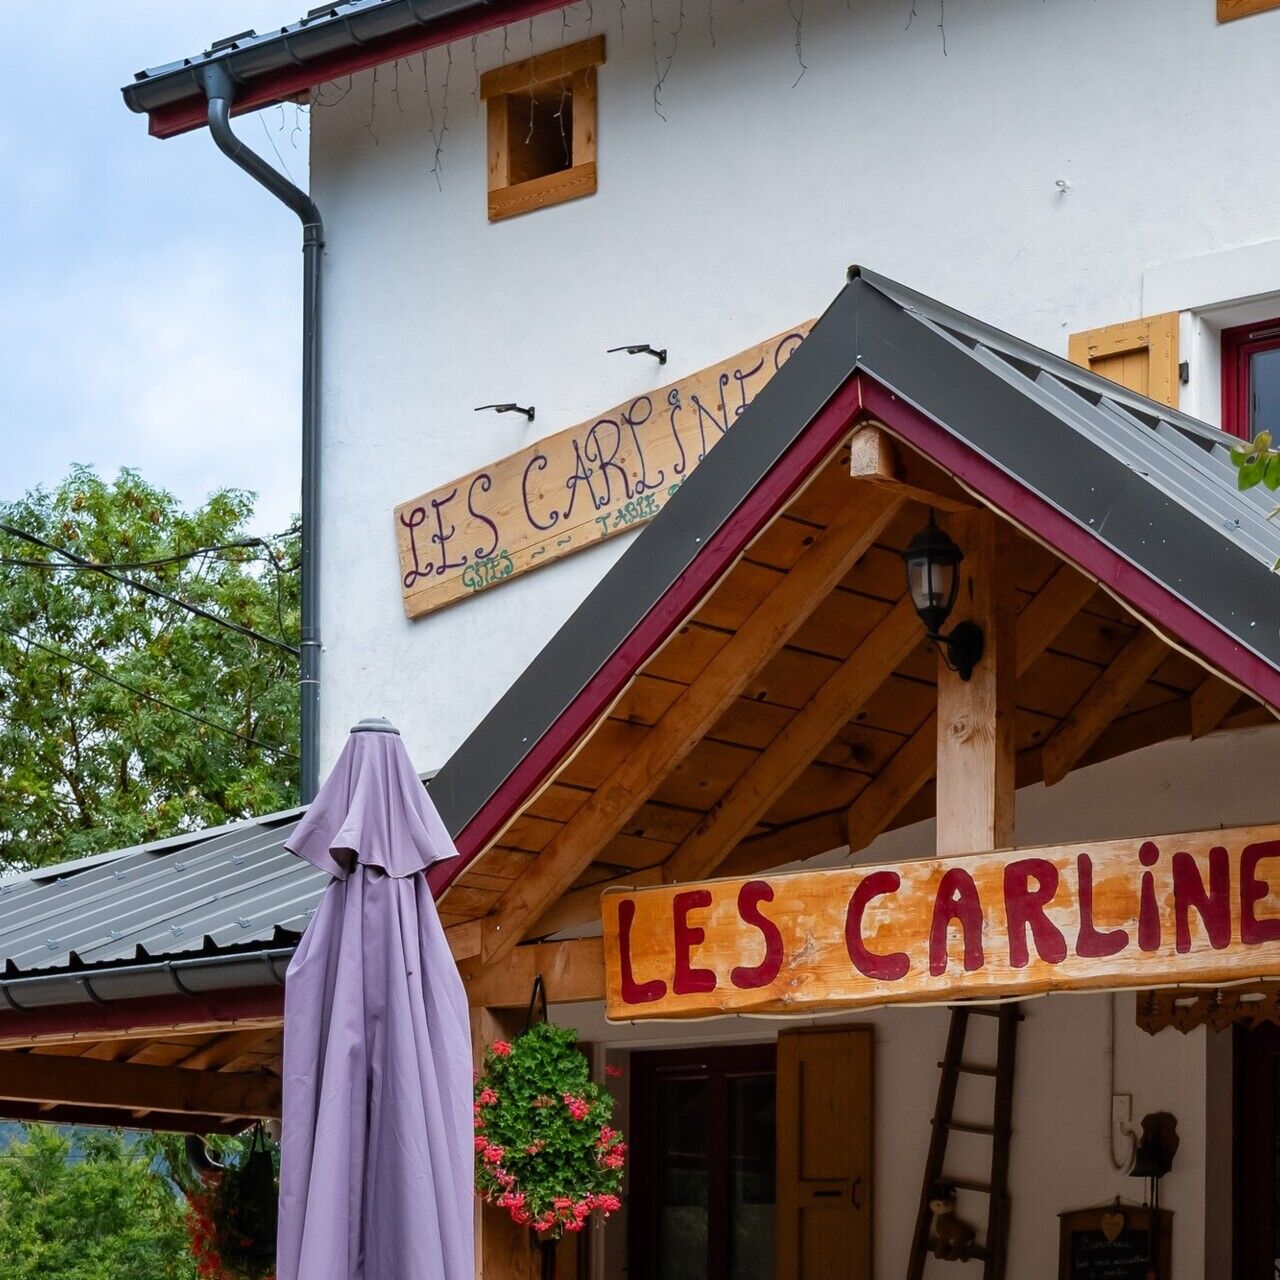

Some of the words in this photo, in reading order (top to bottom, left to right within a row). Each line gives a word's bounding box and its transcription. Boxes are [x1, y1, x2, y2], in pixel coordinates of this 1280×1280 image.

[400, 473, 500, 589] LES
[594, 491, 661, 540] TABLE
[618, 879, 784, 1005] LES
